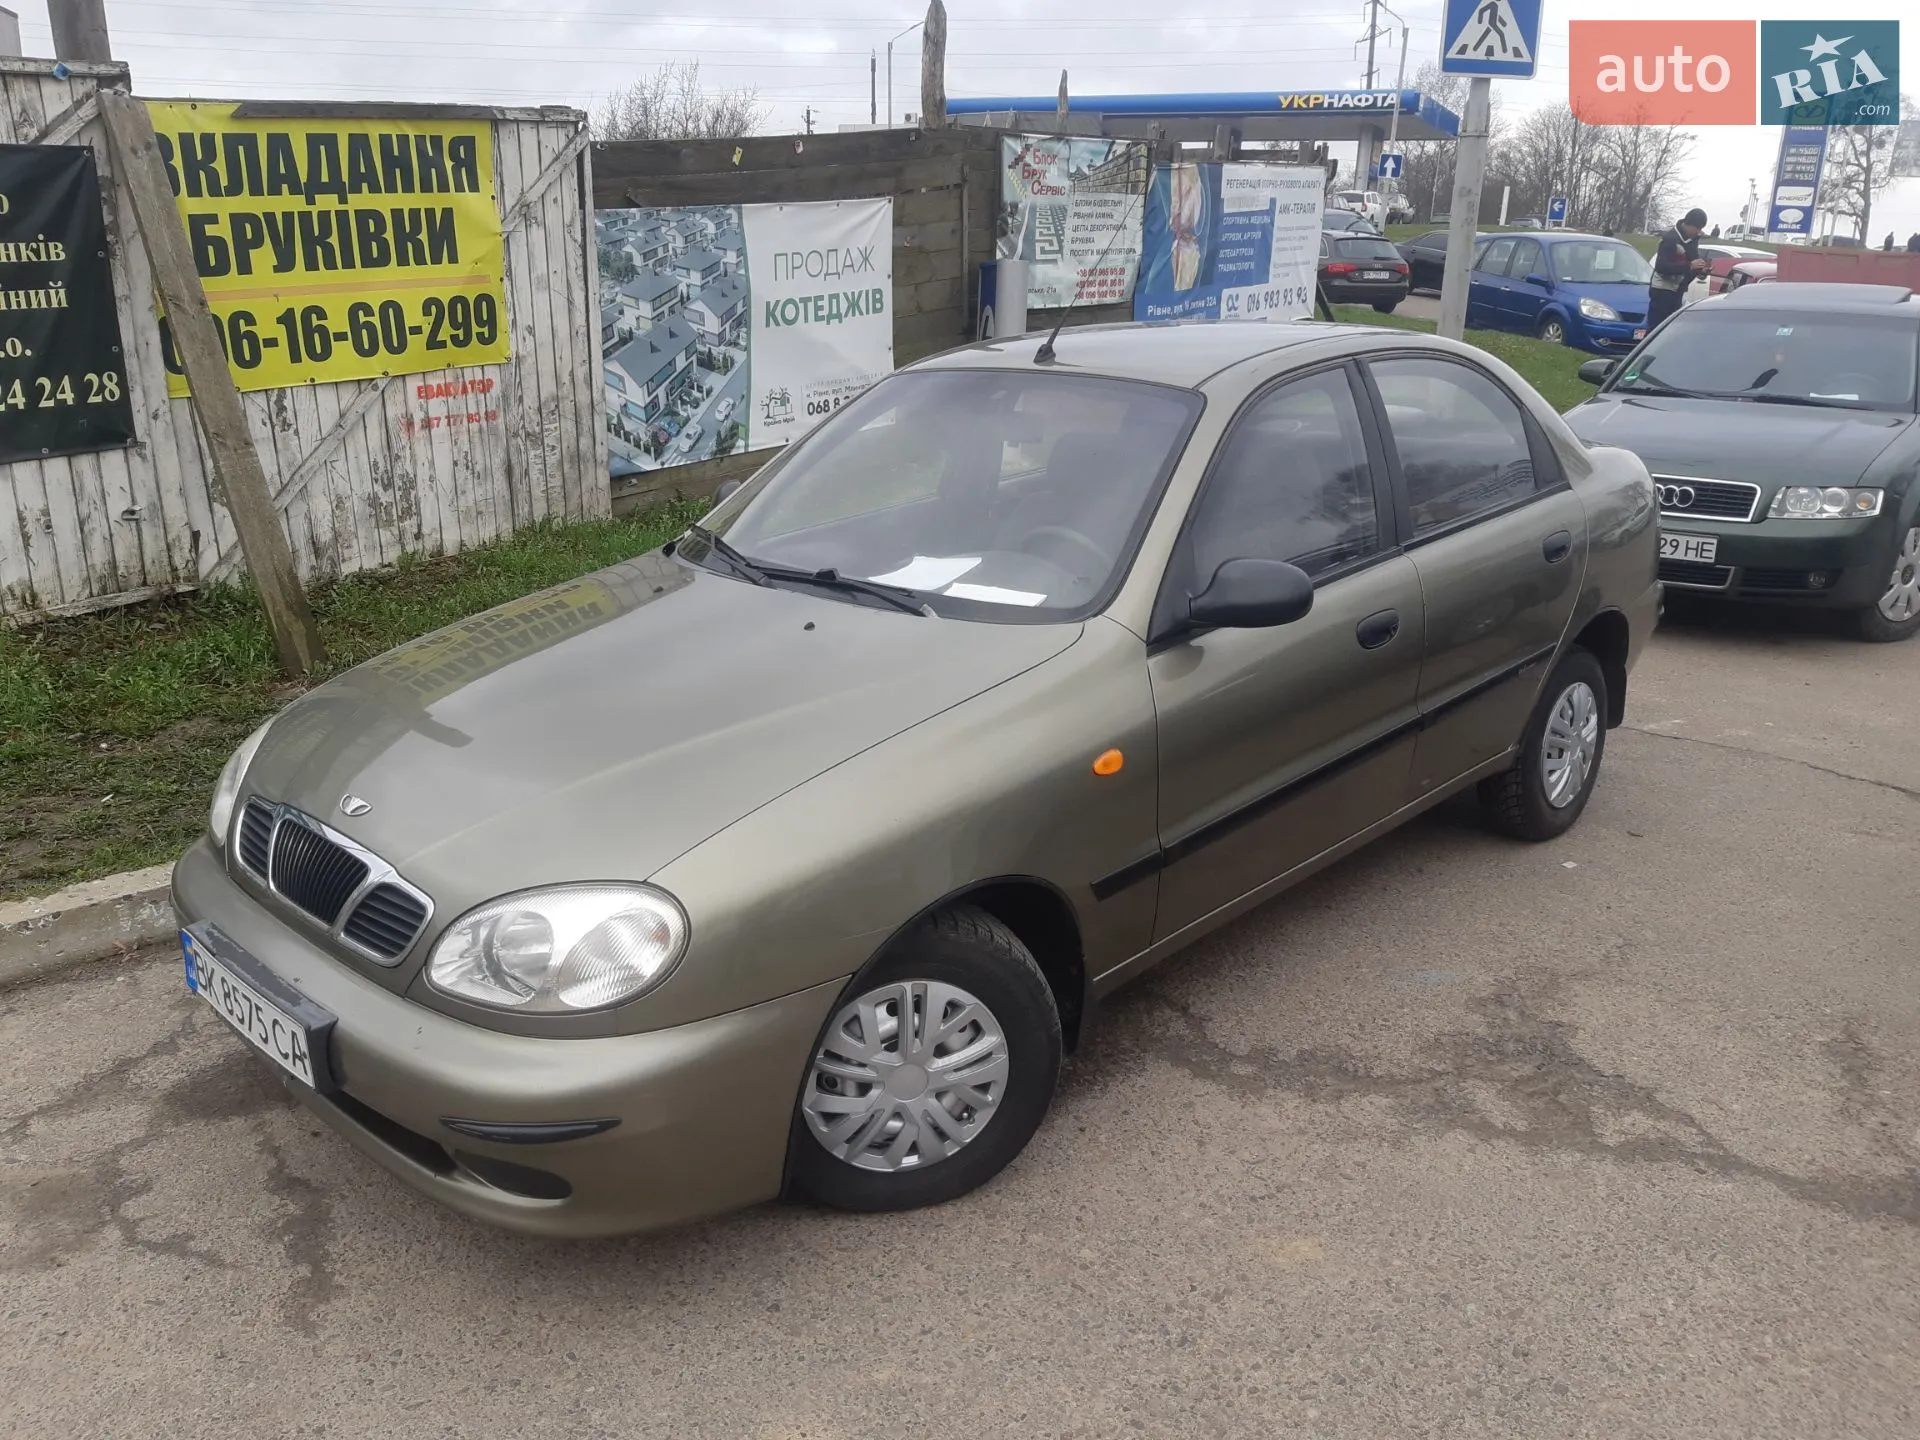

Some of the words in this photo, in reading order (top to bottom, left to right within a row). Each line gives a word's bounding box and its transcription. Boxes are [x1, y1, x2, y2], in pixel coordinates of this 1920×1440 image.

[1278, 93, 1397, 109] УКРНАФТА
[188, 207, 459, 278] БРУКІВКИ
[773, 246, 875, 282] ПРОДАЖ
[765, 287, 884, 328] КОТЕДЖІВ
[1147, 304, 1173, 316] Рівне,
[1247, 293, 1260, 314] 096
[1264, 291, 1279, 310] 983
[1283, 289, 1293, 307] 93
[1296, 287, 1307, 305] 93
[158, 293, 497, 375] 06-16-60-299
[35, 374, 75, 408] 24
[84, 371, 120, 404] 28
[807, 399, 830, 416] 068
[1660, 538, 1680, 555] 29
[1684, 540, 1715, 559] HE
[194, 948, 222, 1006] BK
[220, 976, 269, 1045] 8575
[272, 1018, 308, 1076] CA
